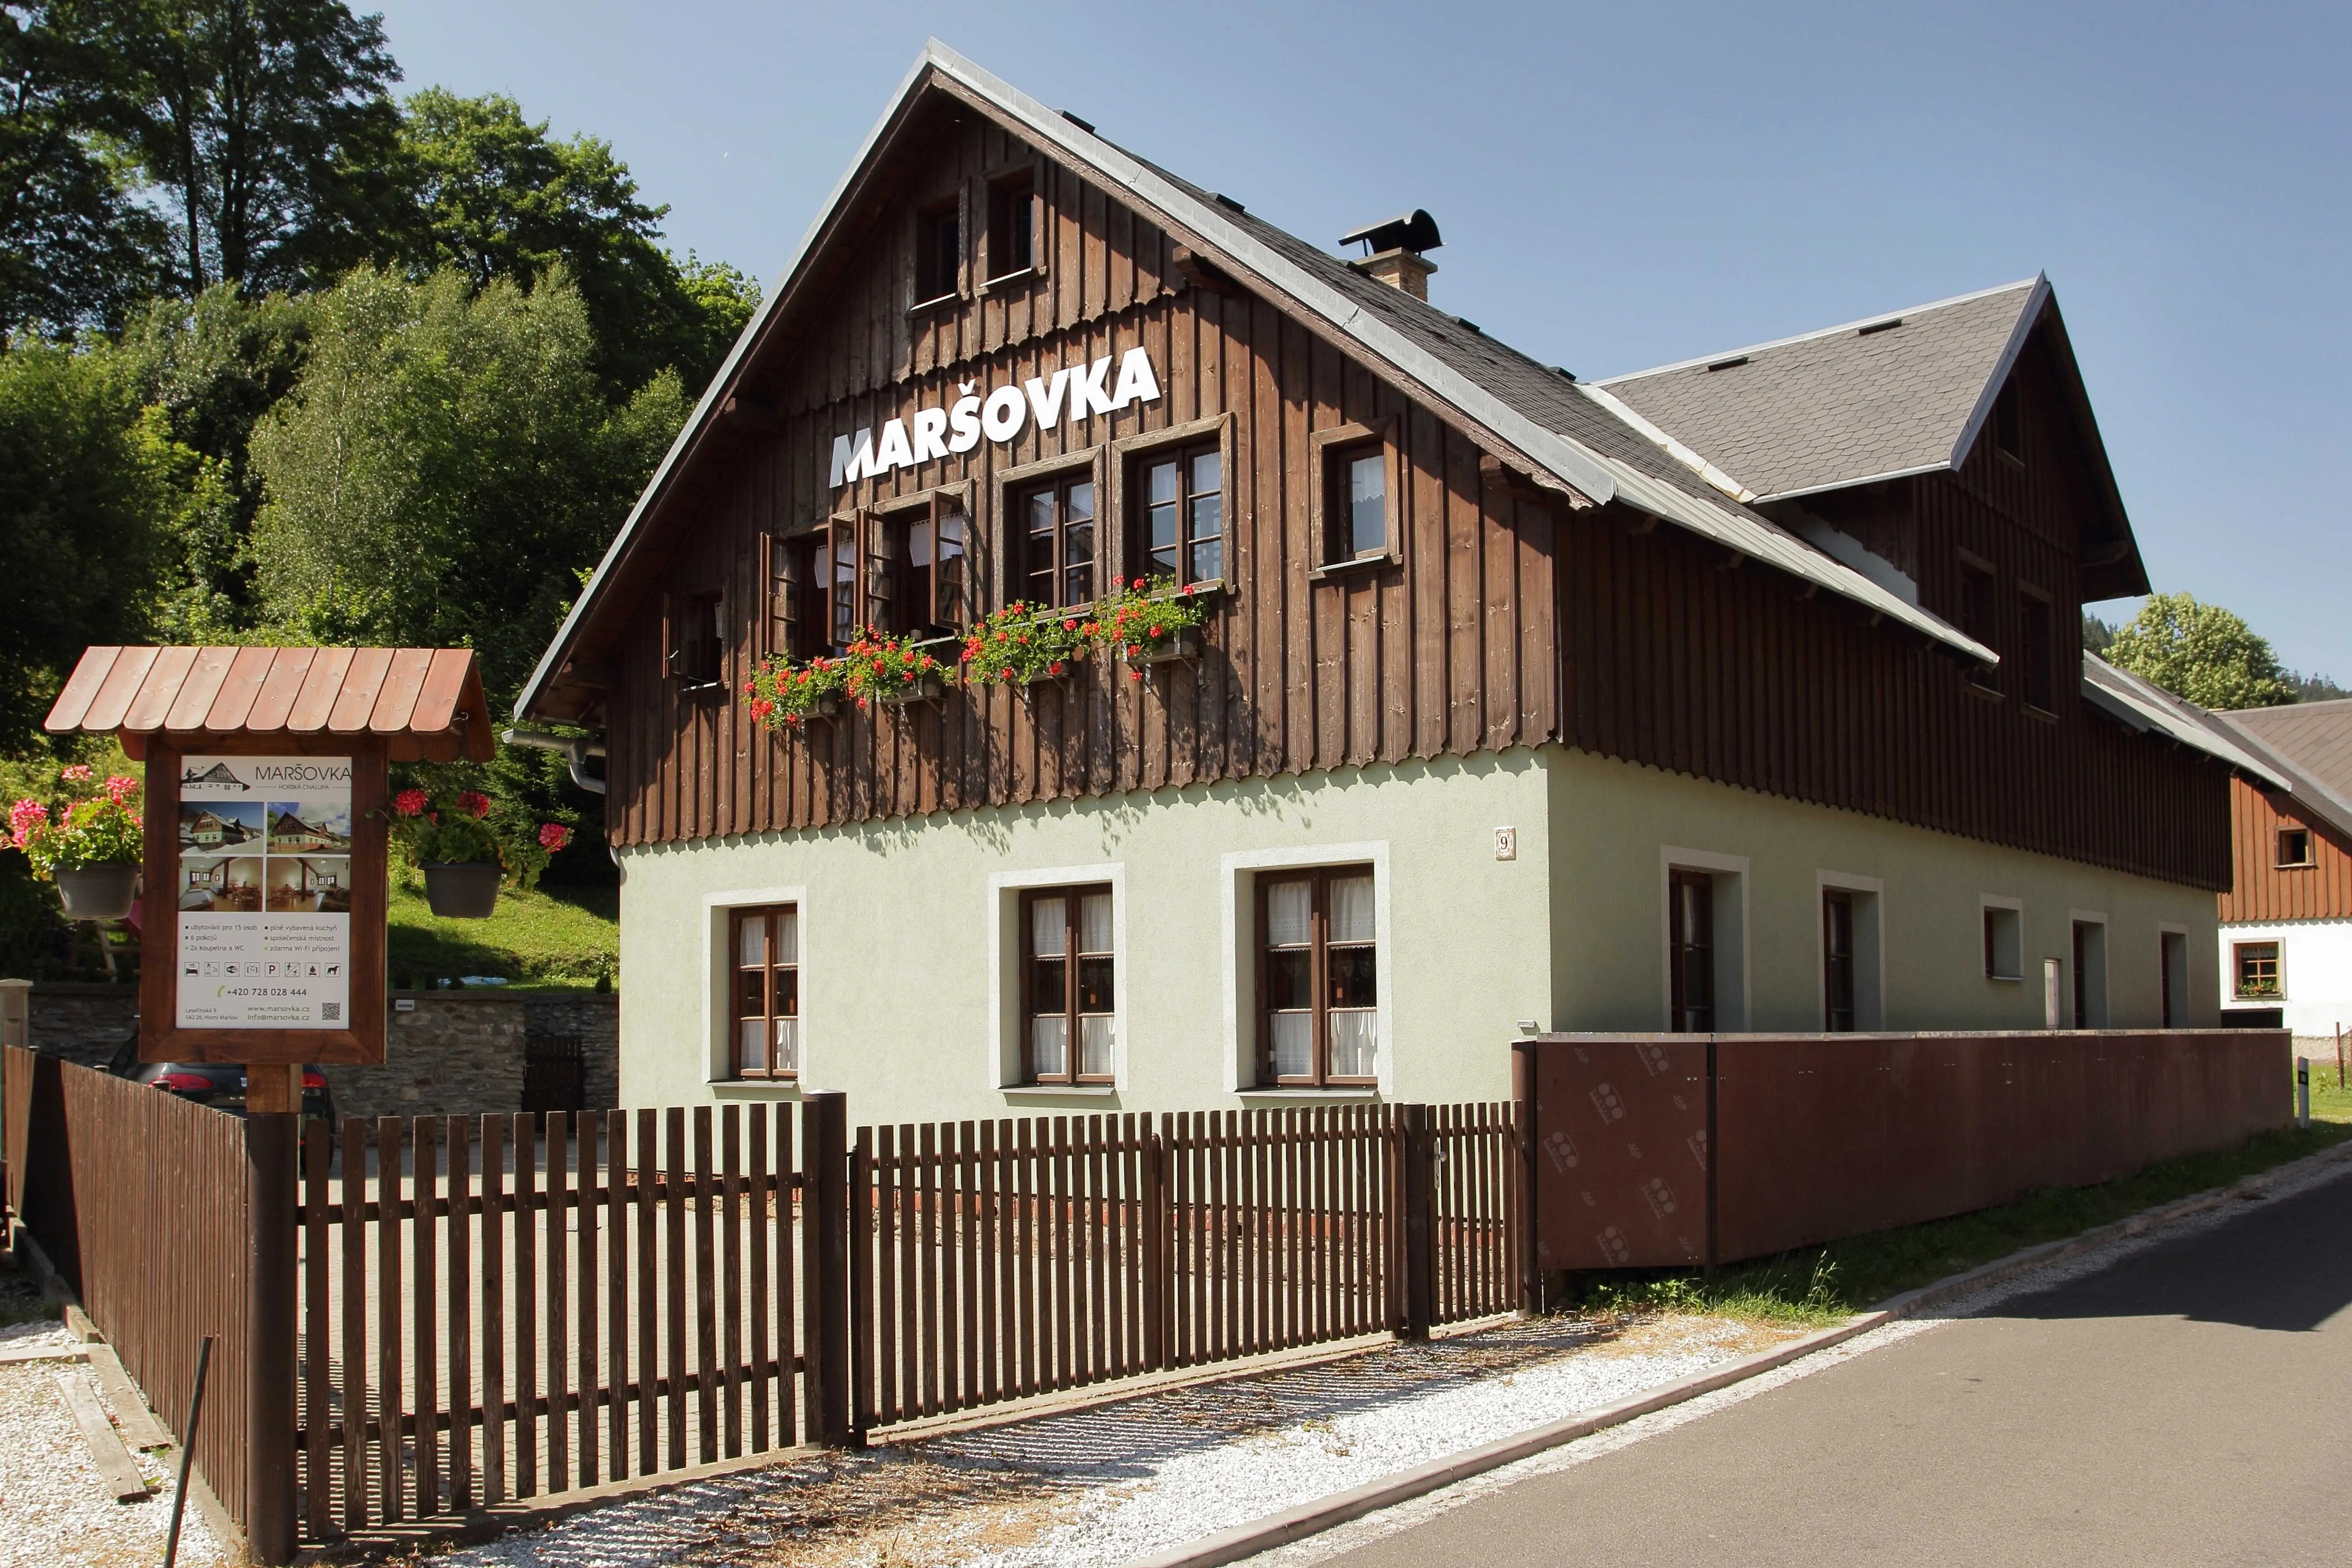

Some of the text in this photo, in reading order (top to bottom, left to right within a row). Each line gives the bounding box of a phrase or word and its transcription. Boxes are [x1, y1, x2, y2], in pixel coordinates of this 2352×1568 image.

[829, 346, 1160, 488] MARŠOVKA
[255, 764, 352, 781] MARŠOVKA
[1500, 836, 1508, 849] 9
[269, 965, 275, 975] P
